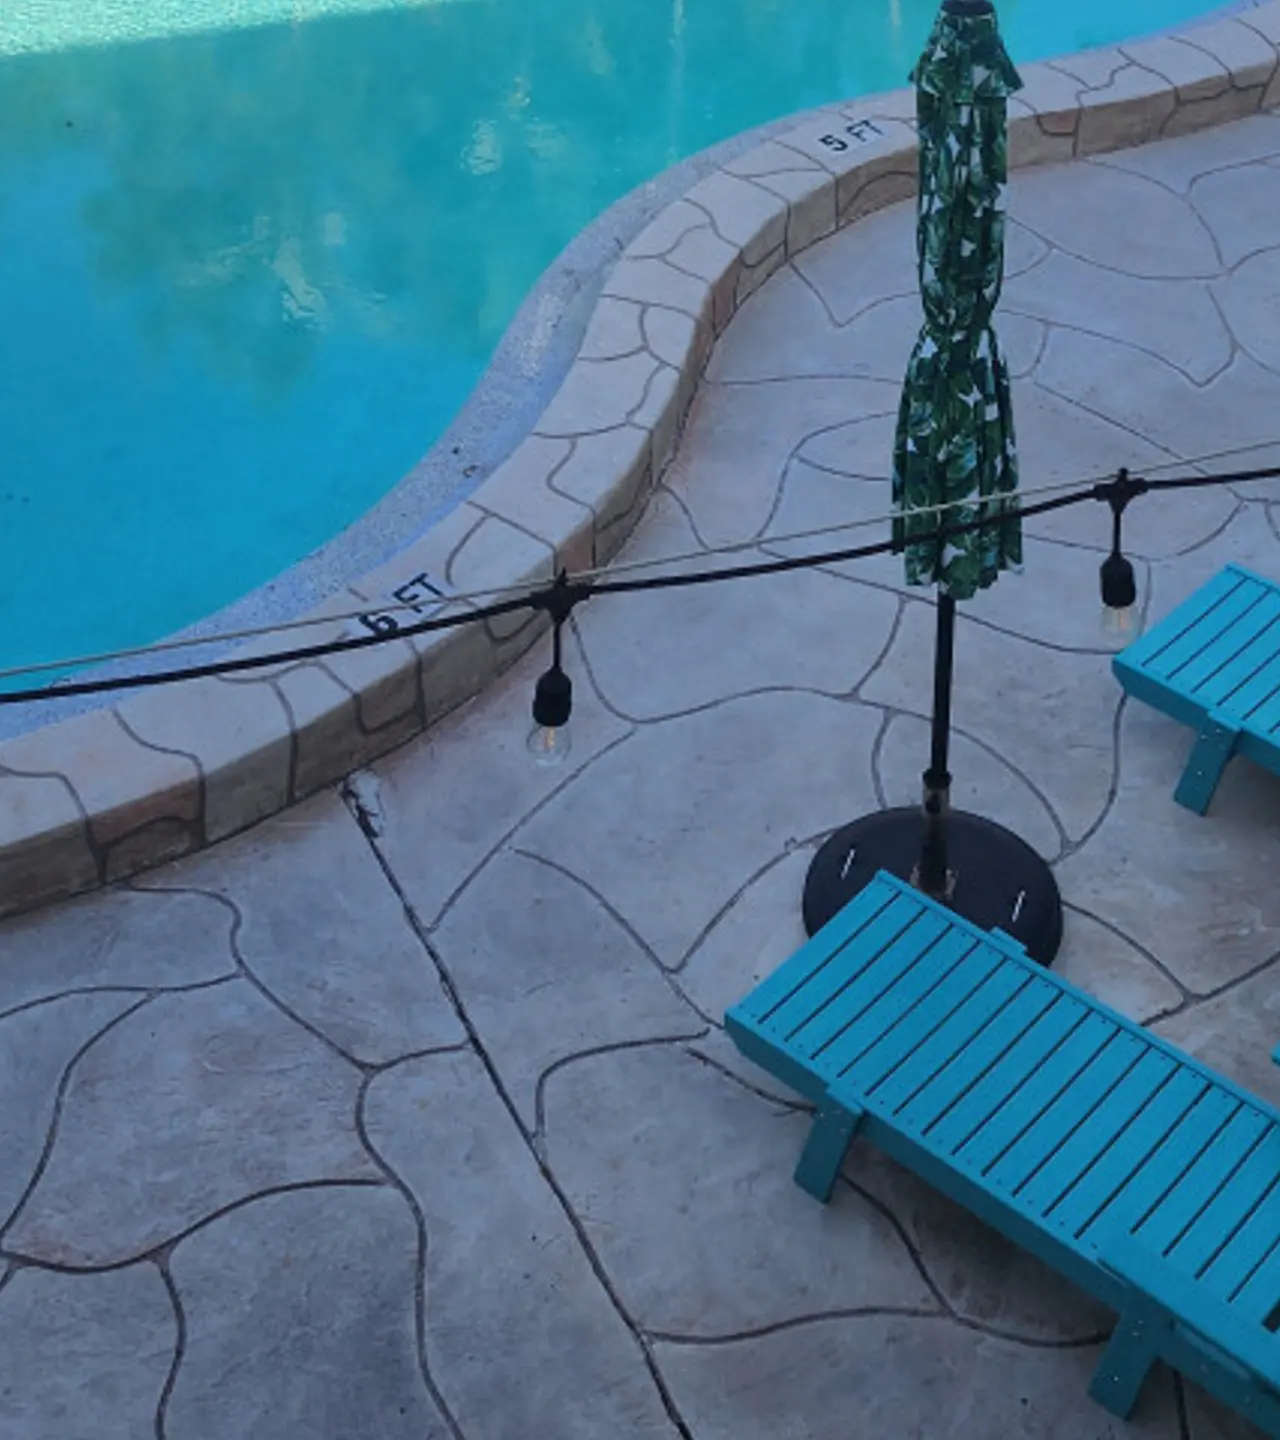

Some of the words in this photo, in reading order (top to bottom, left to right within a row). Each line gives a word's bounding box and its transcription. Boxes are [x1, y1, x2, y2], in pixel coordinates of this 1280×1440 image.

[818, 134, 849, 152] 5
[845, 119, 884, 143] FT
[393, 572, 444, 614] FT
